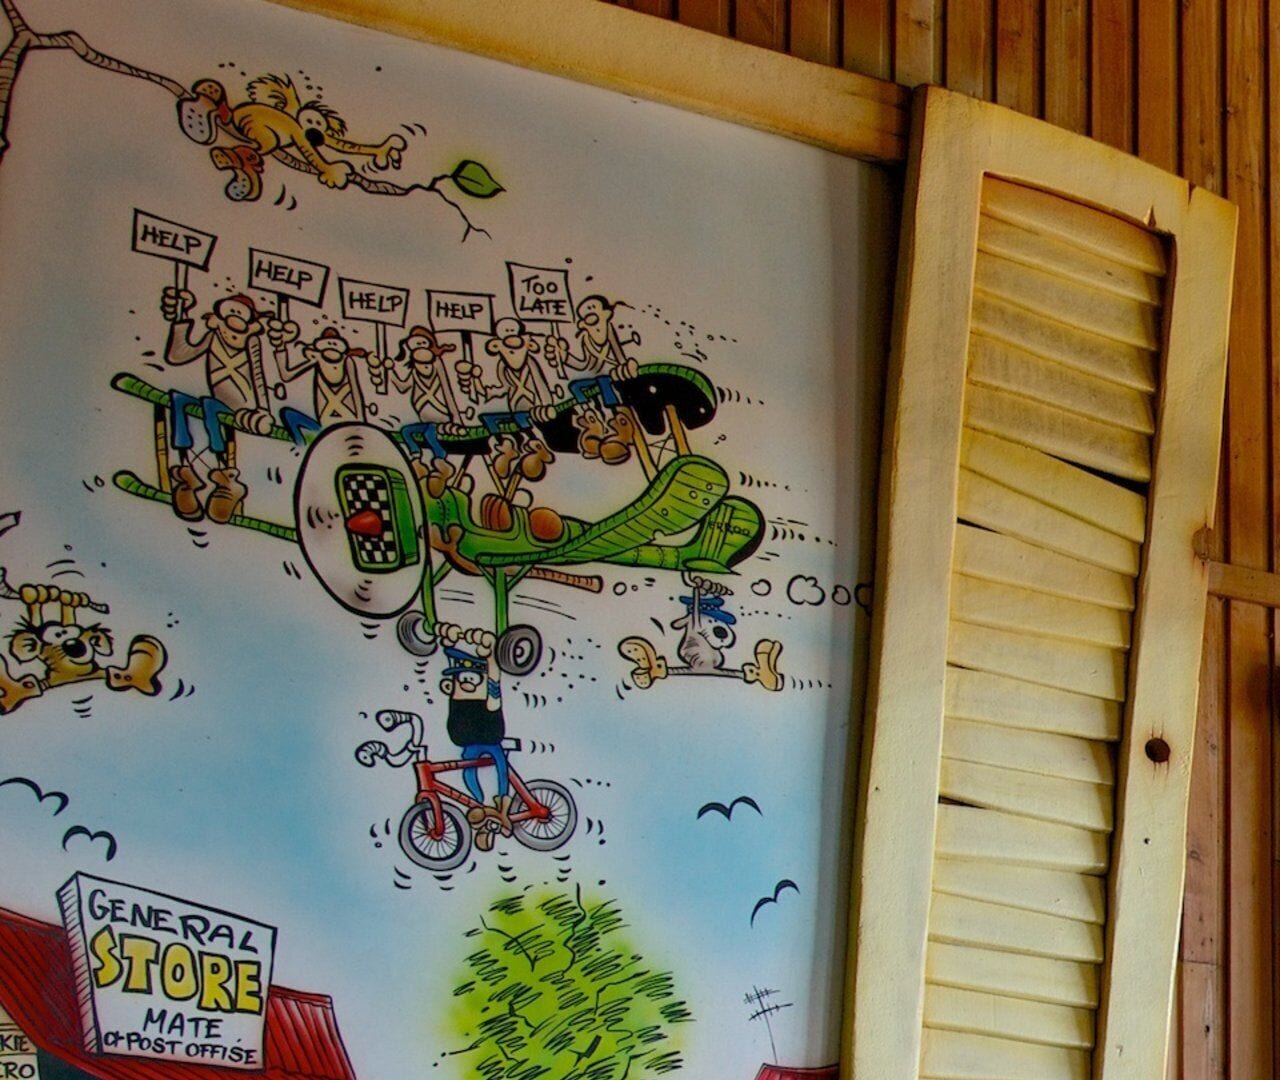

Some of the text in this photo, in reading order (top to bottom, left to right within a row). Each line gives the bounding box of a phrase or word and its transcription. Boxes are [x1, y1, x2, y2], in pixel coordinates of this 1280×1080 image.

[141, 224, 202, 254] HELP
[255, 260, 313, 290] HELP
[521, 274, 558, 295] TOO
[349, 291, 403, 312] HELP
[436, 301, 483, 319] HELP
[519, 296, 567, 316] LATE
[88, 889, 259, 954] GENERAL
[90, 924, 263, 1016] STORE
[143, 1008, 224, 1039] MATE
[127, 1031, 182, 1056] POST
